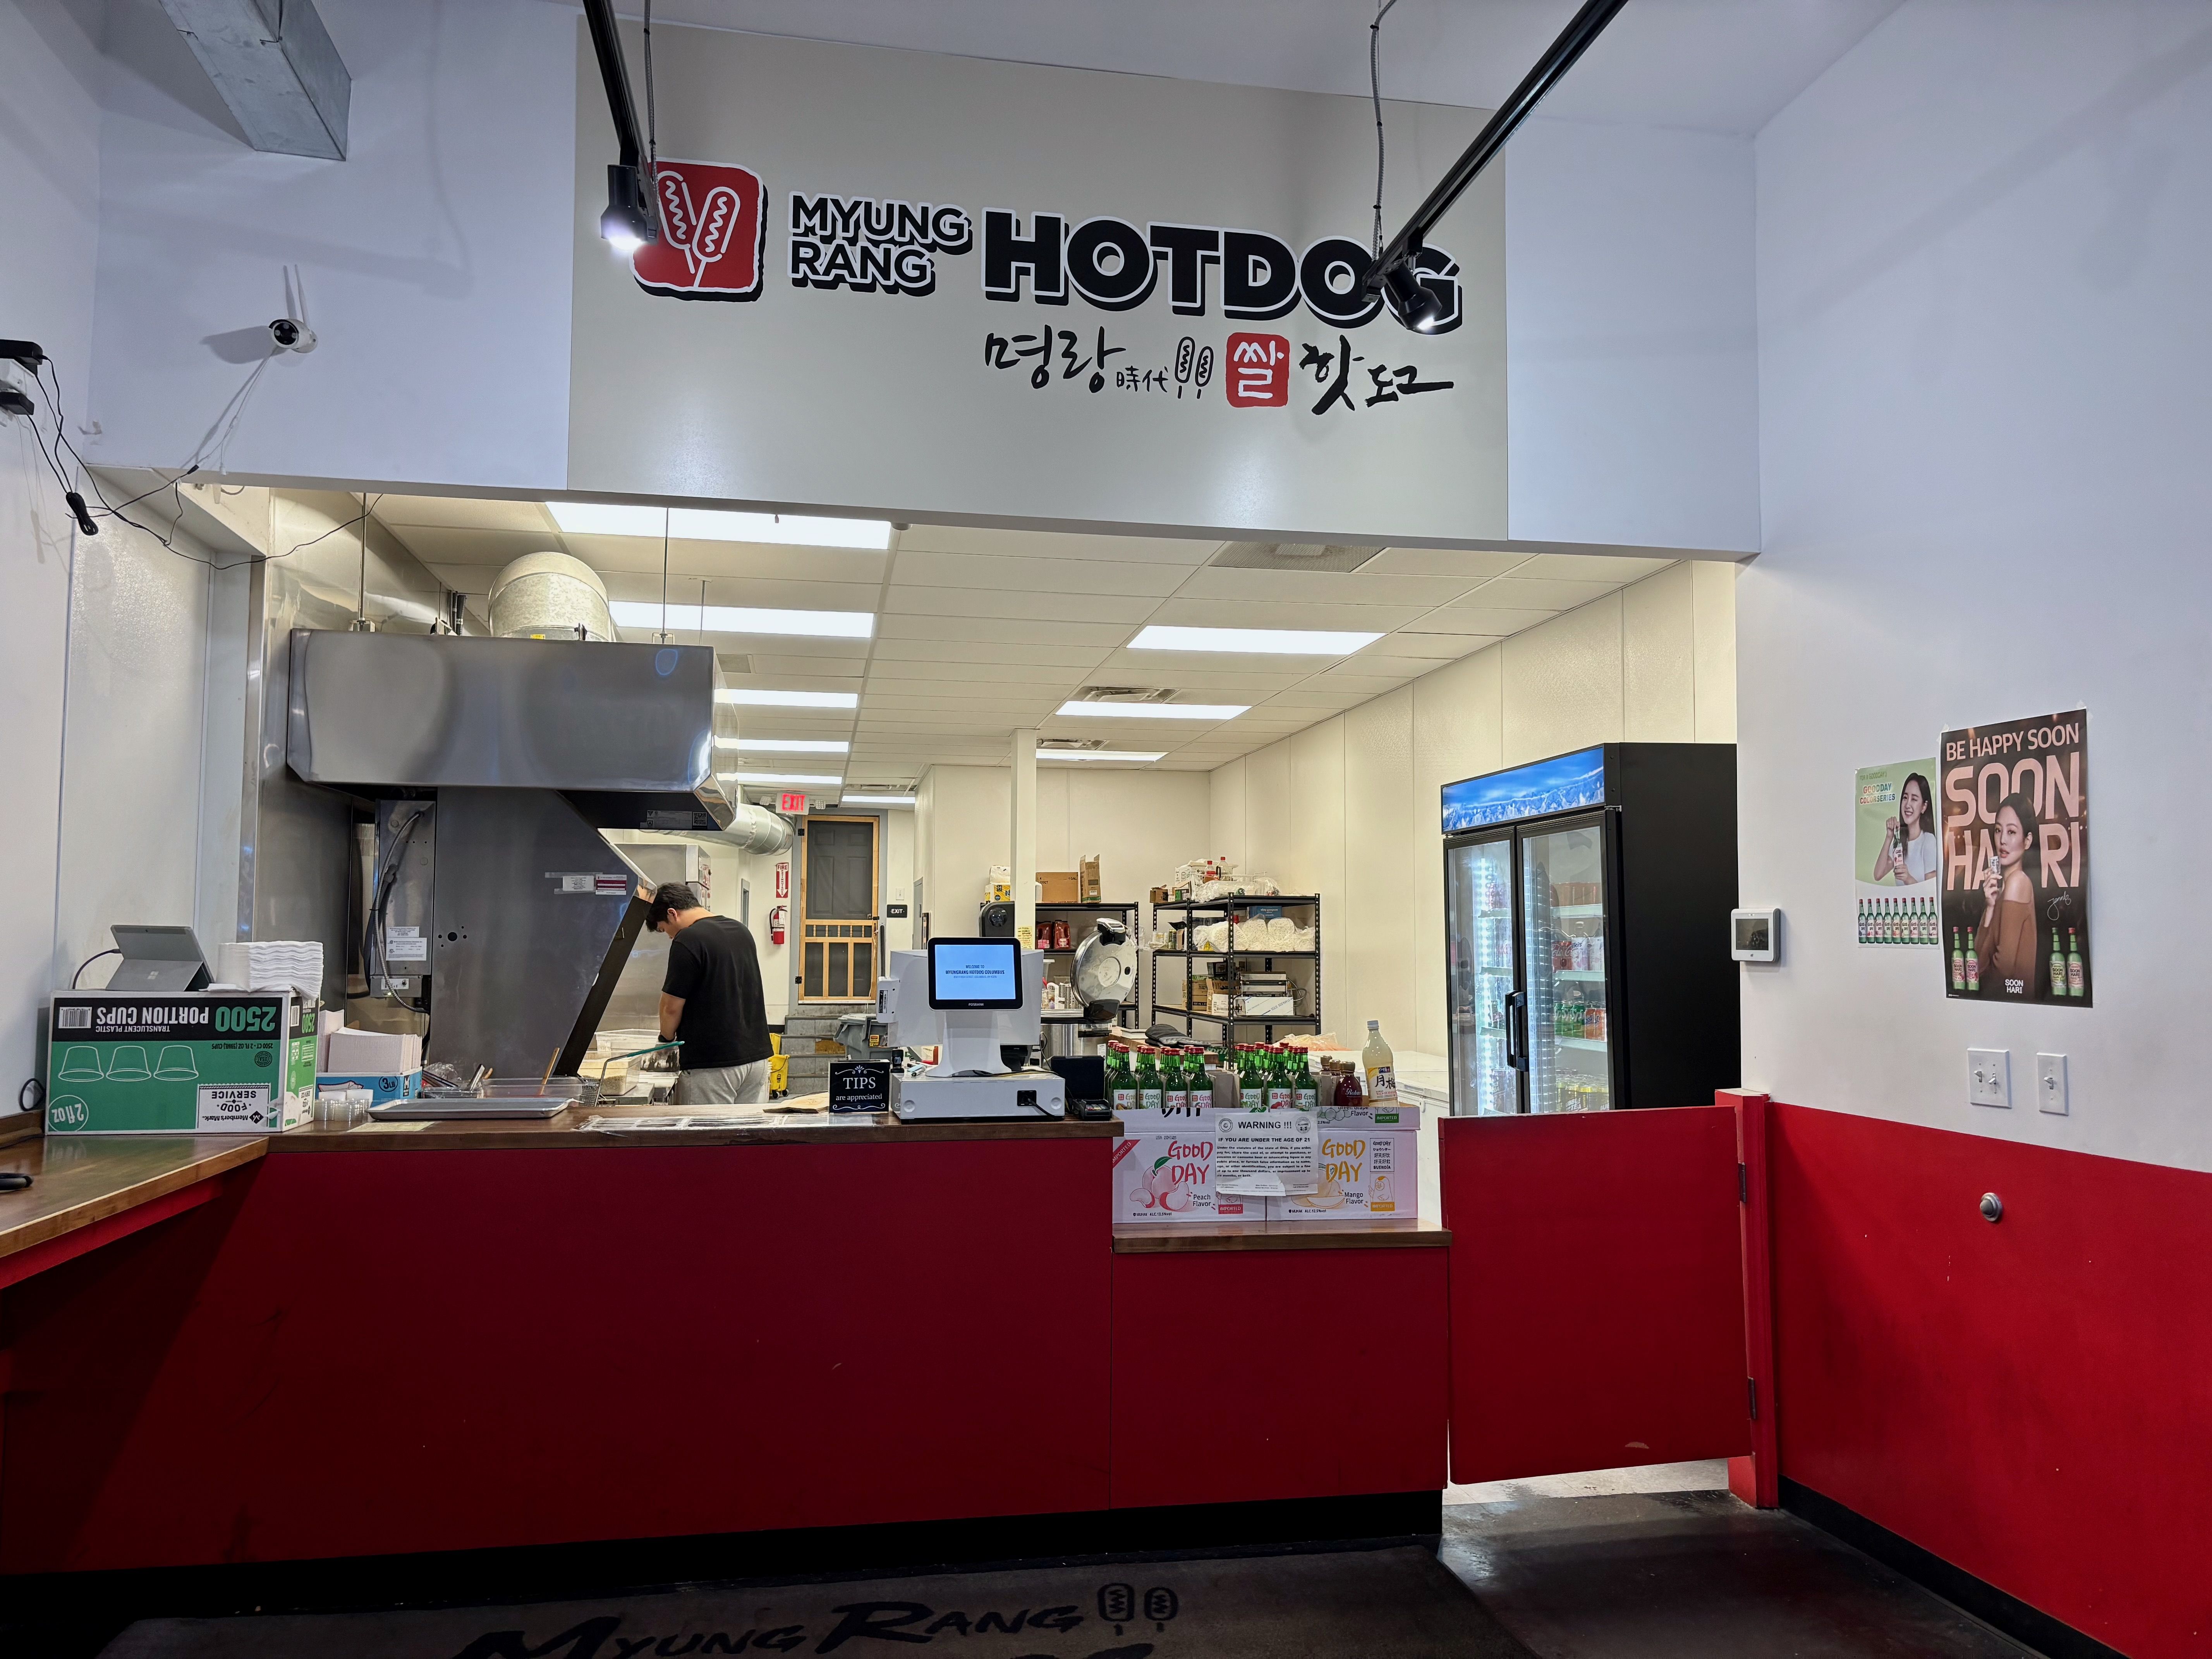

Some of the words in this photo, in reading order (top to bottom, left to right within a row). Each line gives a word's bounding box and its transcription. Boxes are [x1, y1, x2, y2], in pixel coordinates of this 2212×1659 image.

[788, 191, 973, 256] MYUNG
[788, 237, 935, 297] RANG
[981, 207, 1462, 335] HOTDOG
[1946, 740, 1966, 761] BE
[1970, 731, 2024, 758] HAPPY
[2028, 722, 2079, 750] SOON
[1860, 793, 1895, 804] COLORSERIES
[1863, 783, 1892, 794] GOODDAY
[1946, 751, 2080, 827] SOON
[781, 793, 805, 812] EXIT
[1947, 822, 2080, 891] HARI
[97, 1007, 137, 1025] CUPS
[142, 1007, 209, 1024] PORTION
[215, 1006, 276, 1032] 2500
[302, 1013, 315, 1034] 2500
[843, 1077, 876, 1089] TIPS
[211, 1091, 256, 1099] SERVICE
[847, 1093, 882, 1101] appreciated
[1146, 1101, 1159, 1109] DAY
[51, 1107, 65, 1123] oz
[74, 1103, 84, 1119] 2
[220, 1102, 247, 1112] FOOD
[1168, 1140, 1213, 1161] GOOD
[1321, 1139, 1366, 1159] GOOD
[1171, 1163, 1210, 1185] DAY
[1326, 1161, 1363, 1183] DAY
[451, 1616, 806, 1659] MYUNG
[814, 1600, 1085, 1656] RANG
